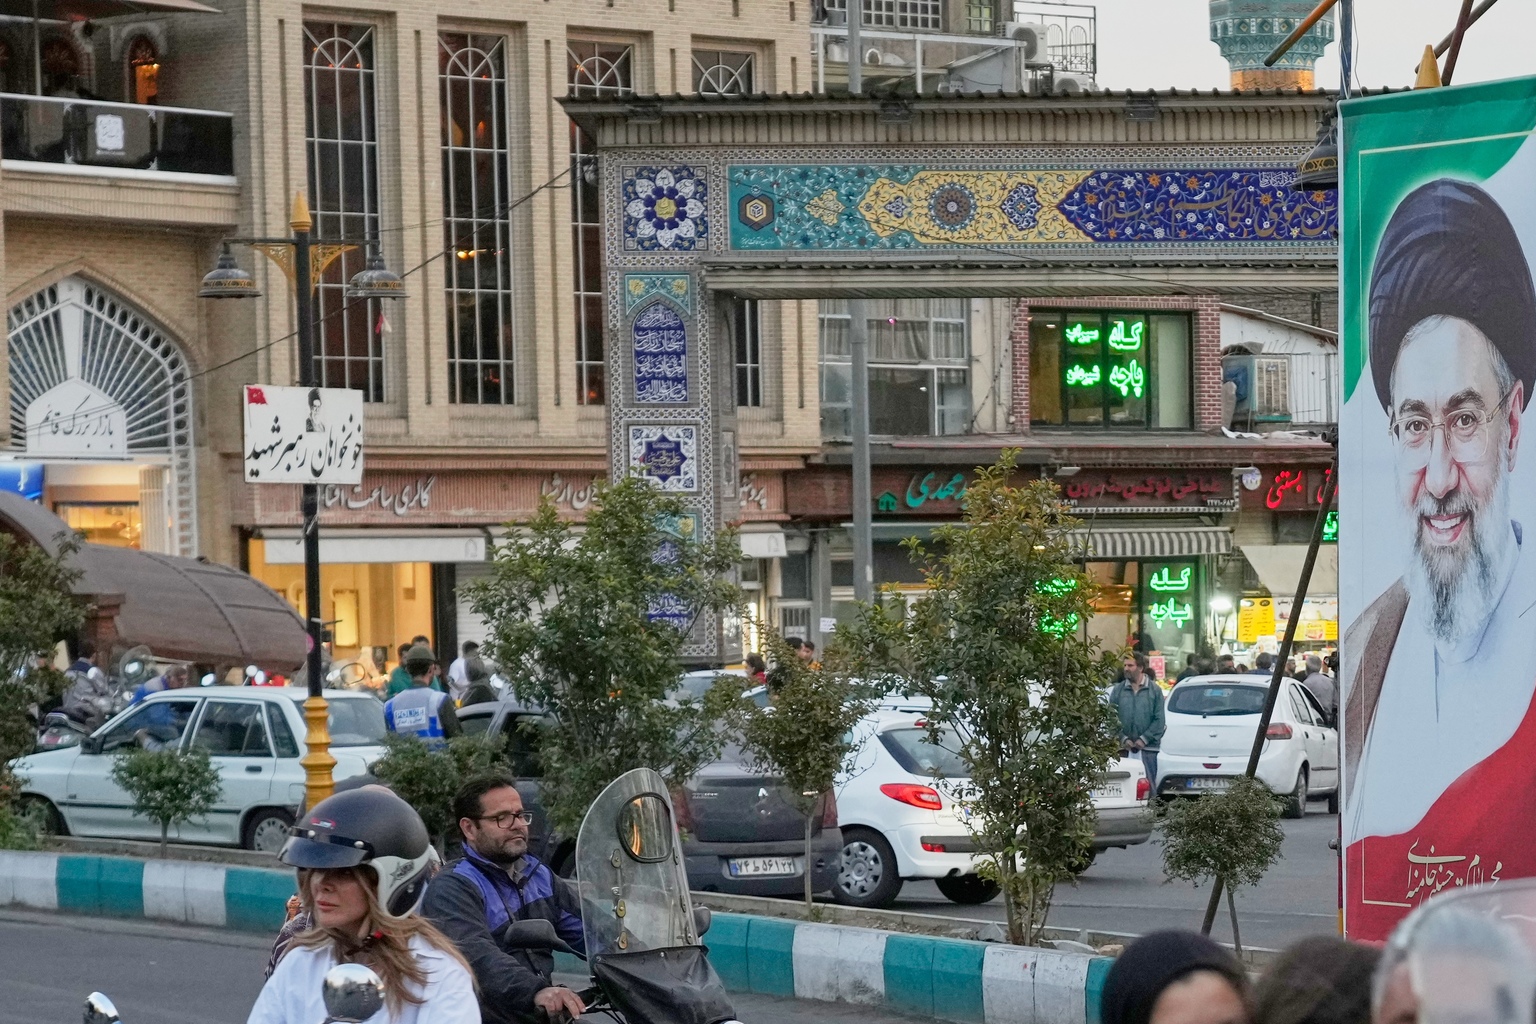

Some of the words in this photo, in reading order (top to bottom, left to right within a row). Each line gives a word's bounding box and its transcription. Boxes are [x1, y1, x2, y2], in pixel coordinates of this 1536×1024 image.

[1109, 320, 1143, 350] کله
[246, 415, 284, 478] شهید
[270, 434, 306, 472] رهبر
[310, 414, 362, 478] خونخواهان
[347, 485, 394, 509] ساعت
[395, 474, 437, 516] گالری
[1266, 470, 1303, 509] بستنی
[1150, 567, 1190, 591] کله
